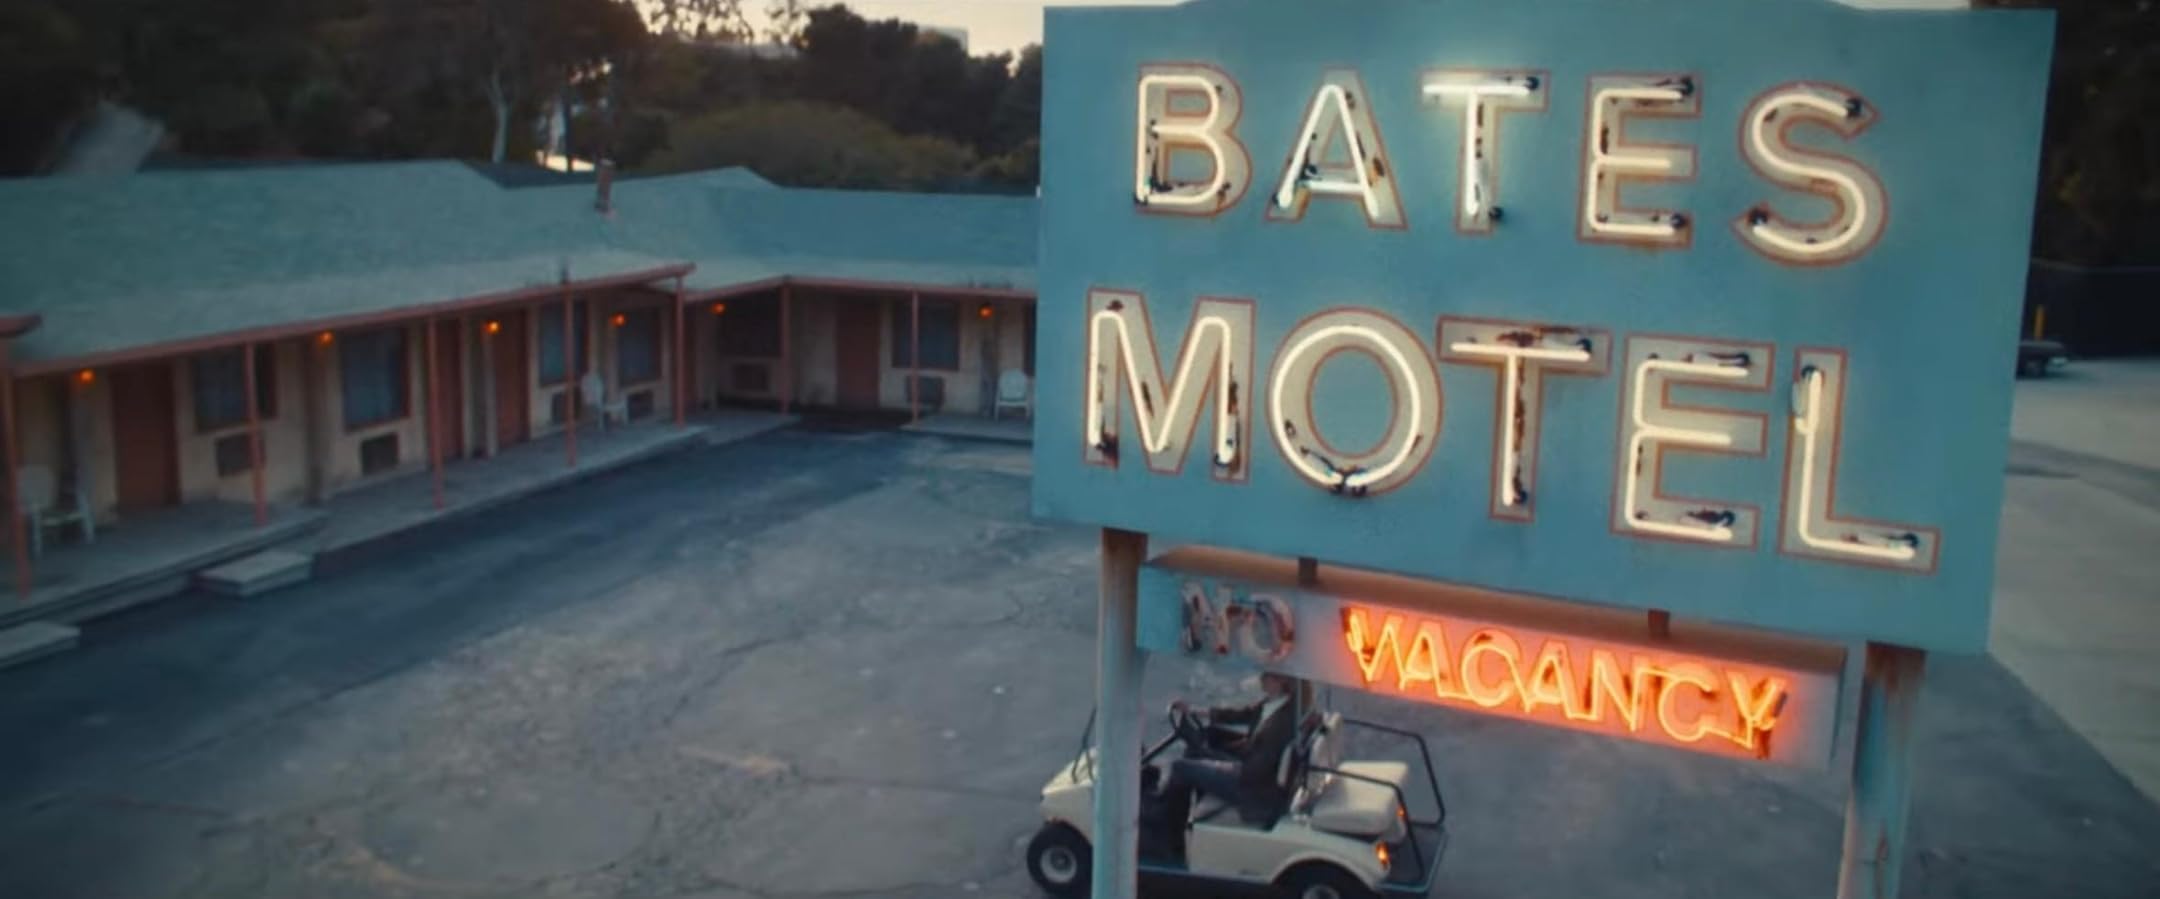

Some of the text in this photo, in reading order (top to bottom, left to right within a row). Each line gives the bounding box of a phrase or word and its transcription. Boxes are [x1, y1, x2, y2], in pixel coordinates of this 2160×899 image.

[1134, 62, 1888, 266] BATES
[1083, 287, 1941, 574] MOTEL
[1181, 580, 1789, 760] NO VACANCY
